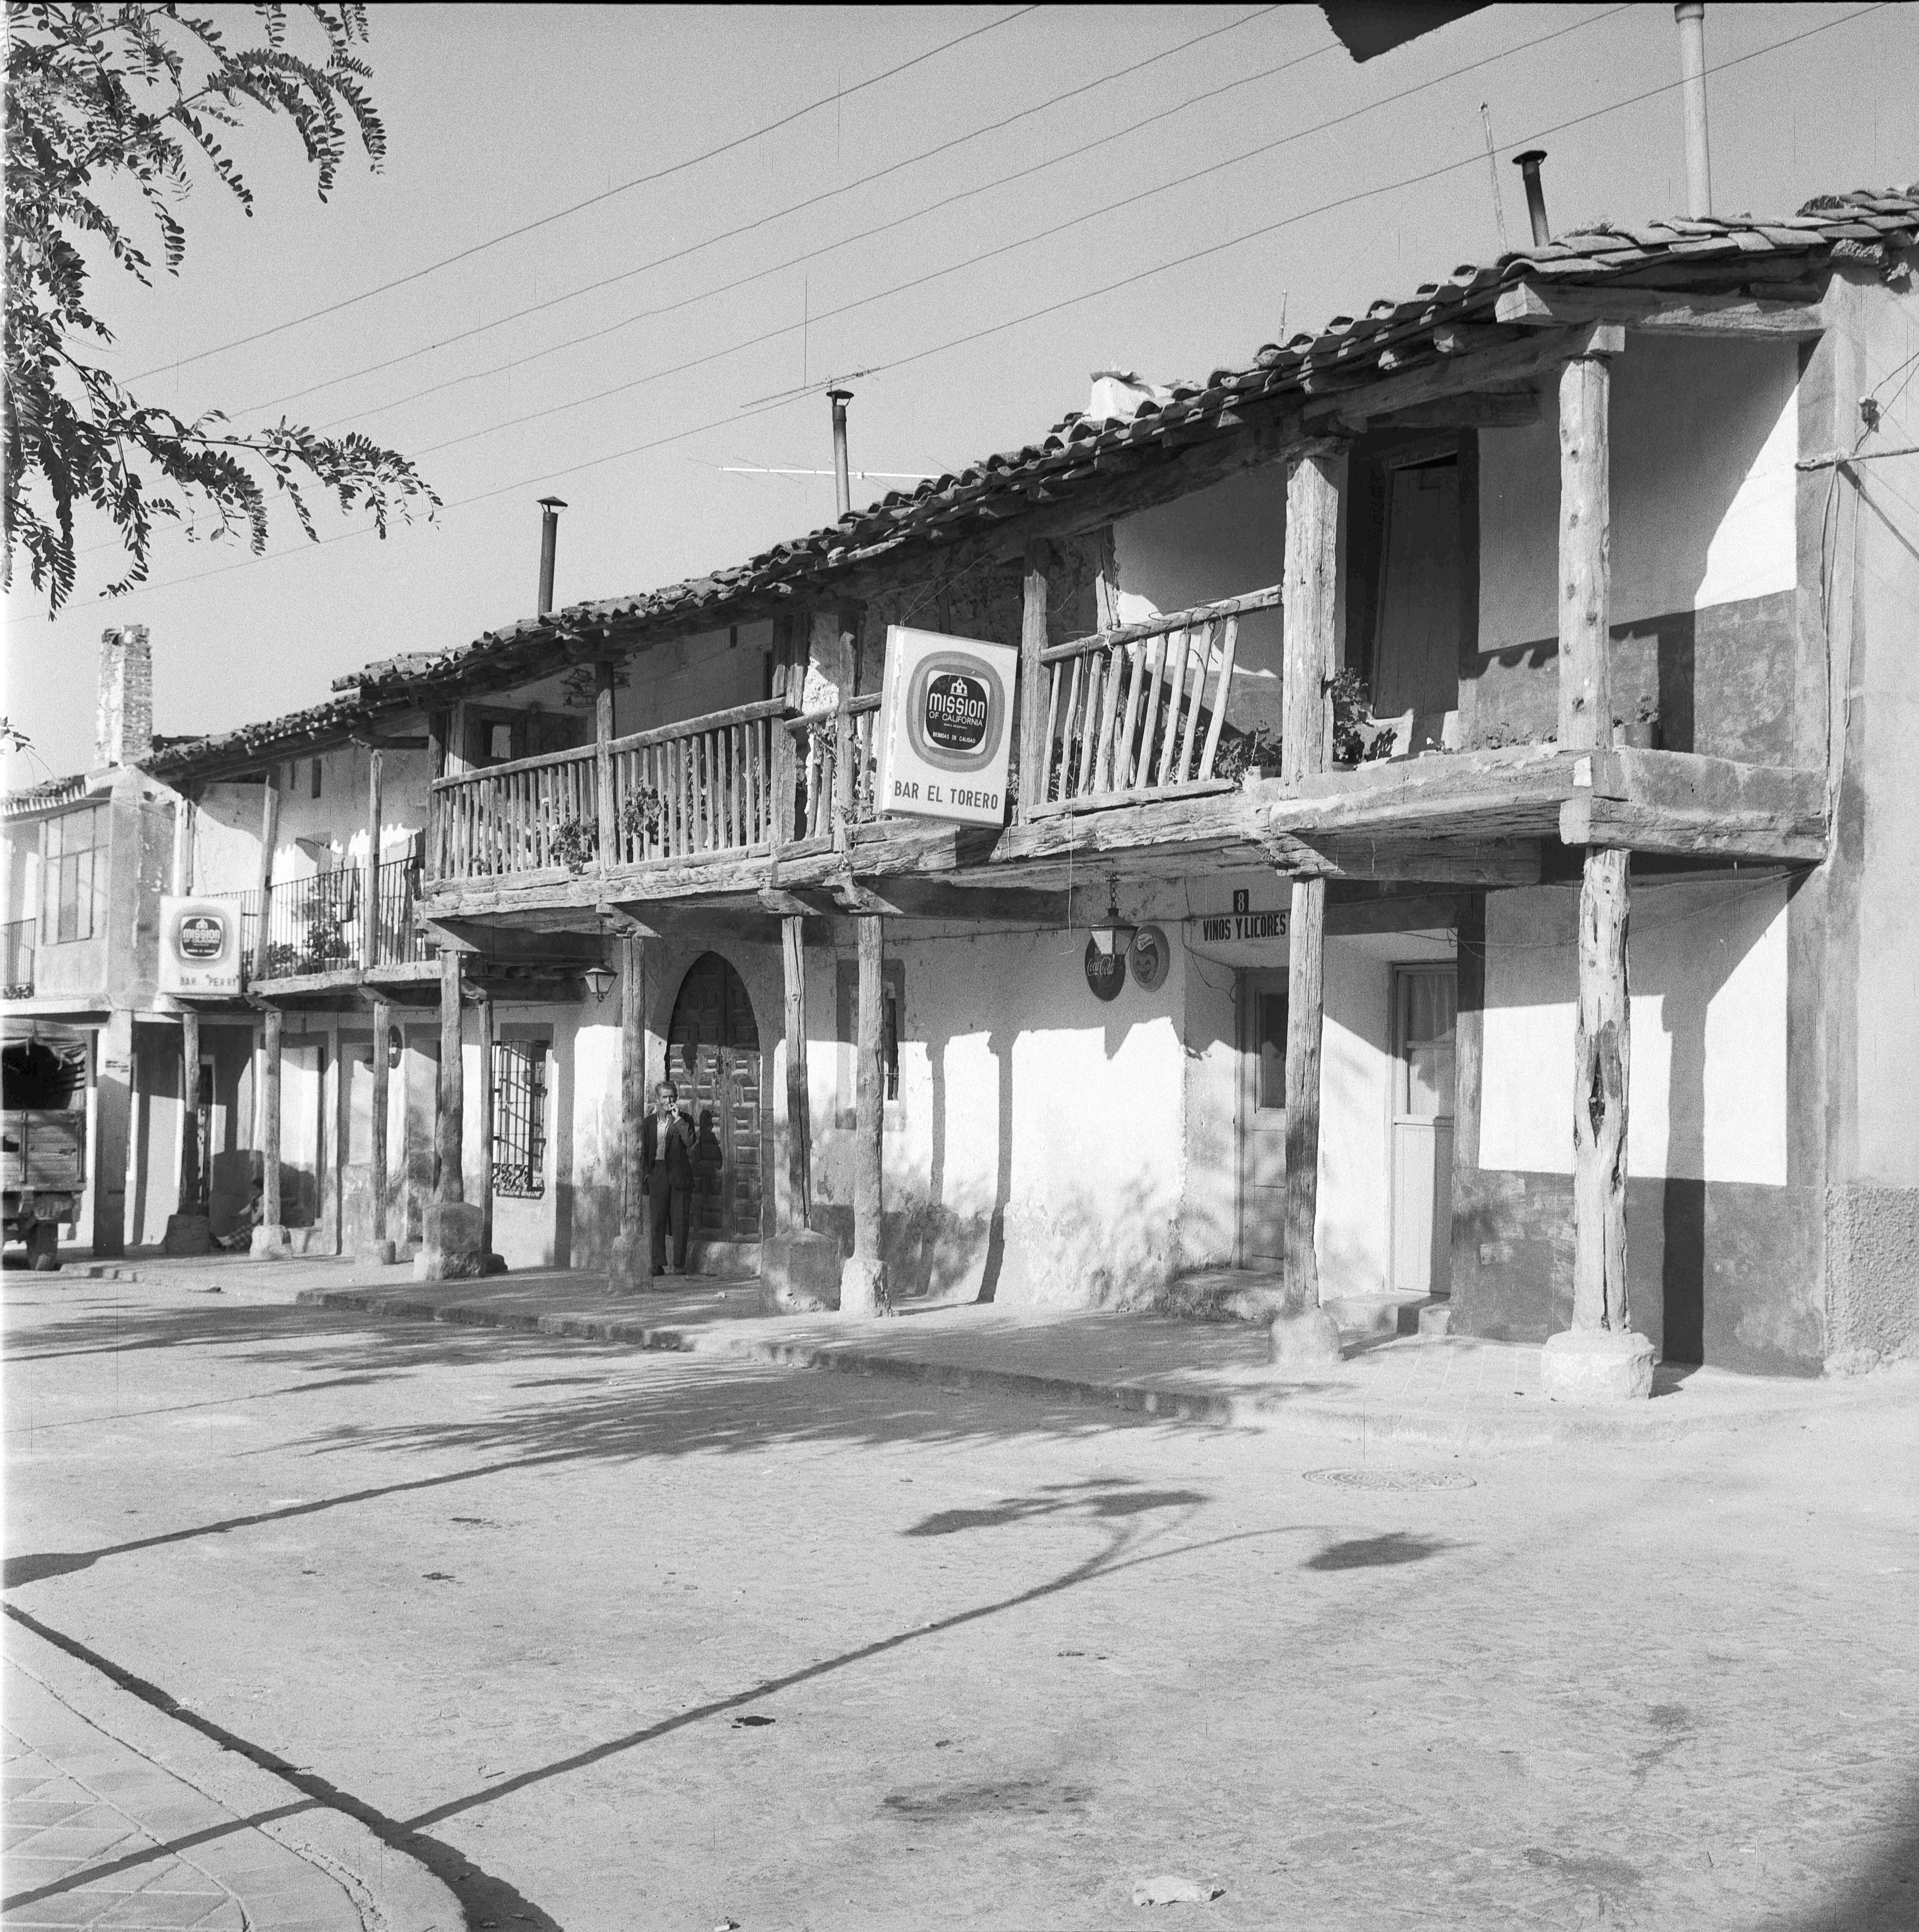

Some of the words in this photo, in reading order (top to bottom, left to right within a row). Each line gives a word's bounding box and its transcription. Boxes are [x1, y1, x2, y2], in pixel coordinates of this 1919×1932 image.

[929, 693, 985, 719] MISSION
[929, 711, 940, 719] OF
[942, 713, 983, 728] CALIFORNIA
[933, 731, 950, 740] BEBIDAS
[959, 736, 976, 744] CALIDAD
[894, 780, 919, 799] BAR
[927, 785, 943, 803] EL
[950, 789, 998, 810] TORERO
[1238, 892, 1245, 912] 8
[1203, 919, 1231, 941] VINOS
[1235, 917, 1243, 940] Y
[1244, 913, 1286, 939] LICORES
[180, 977, 197, 986] BAR
